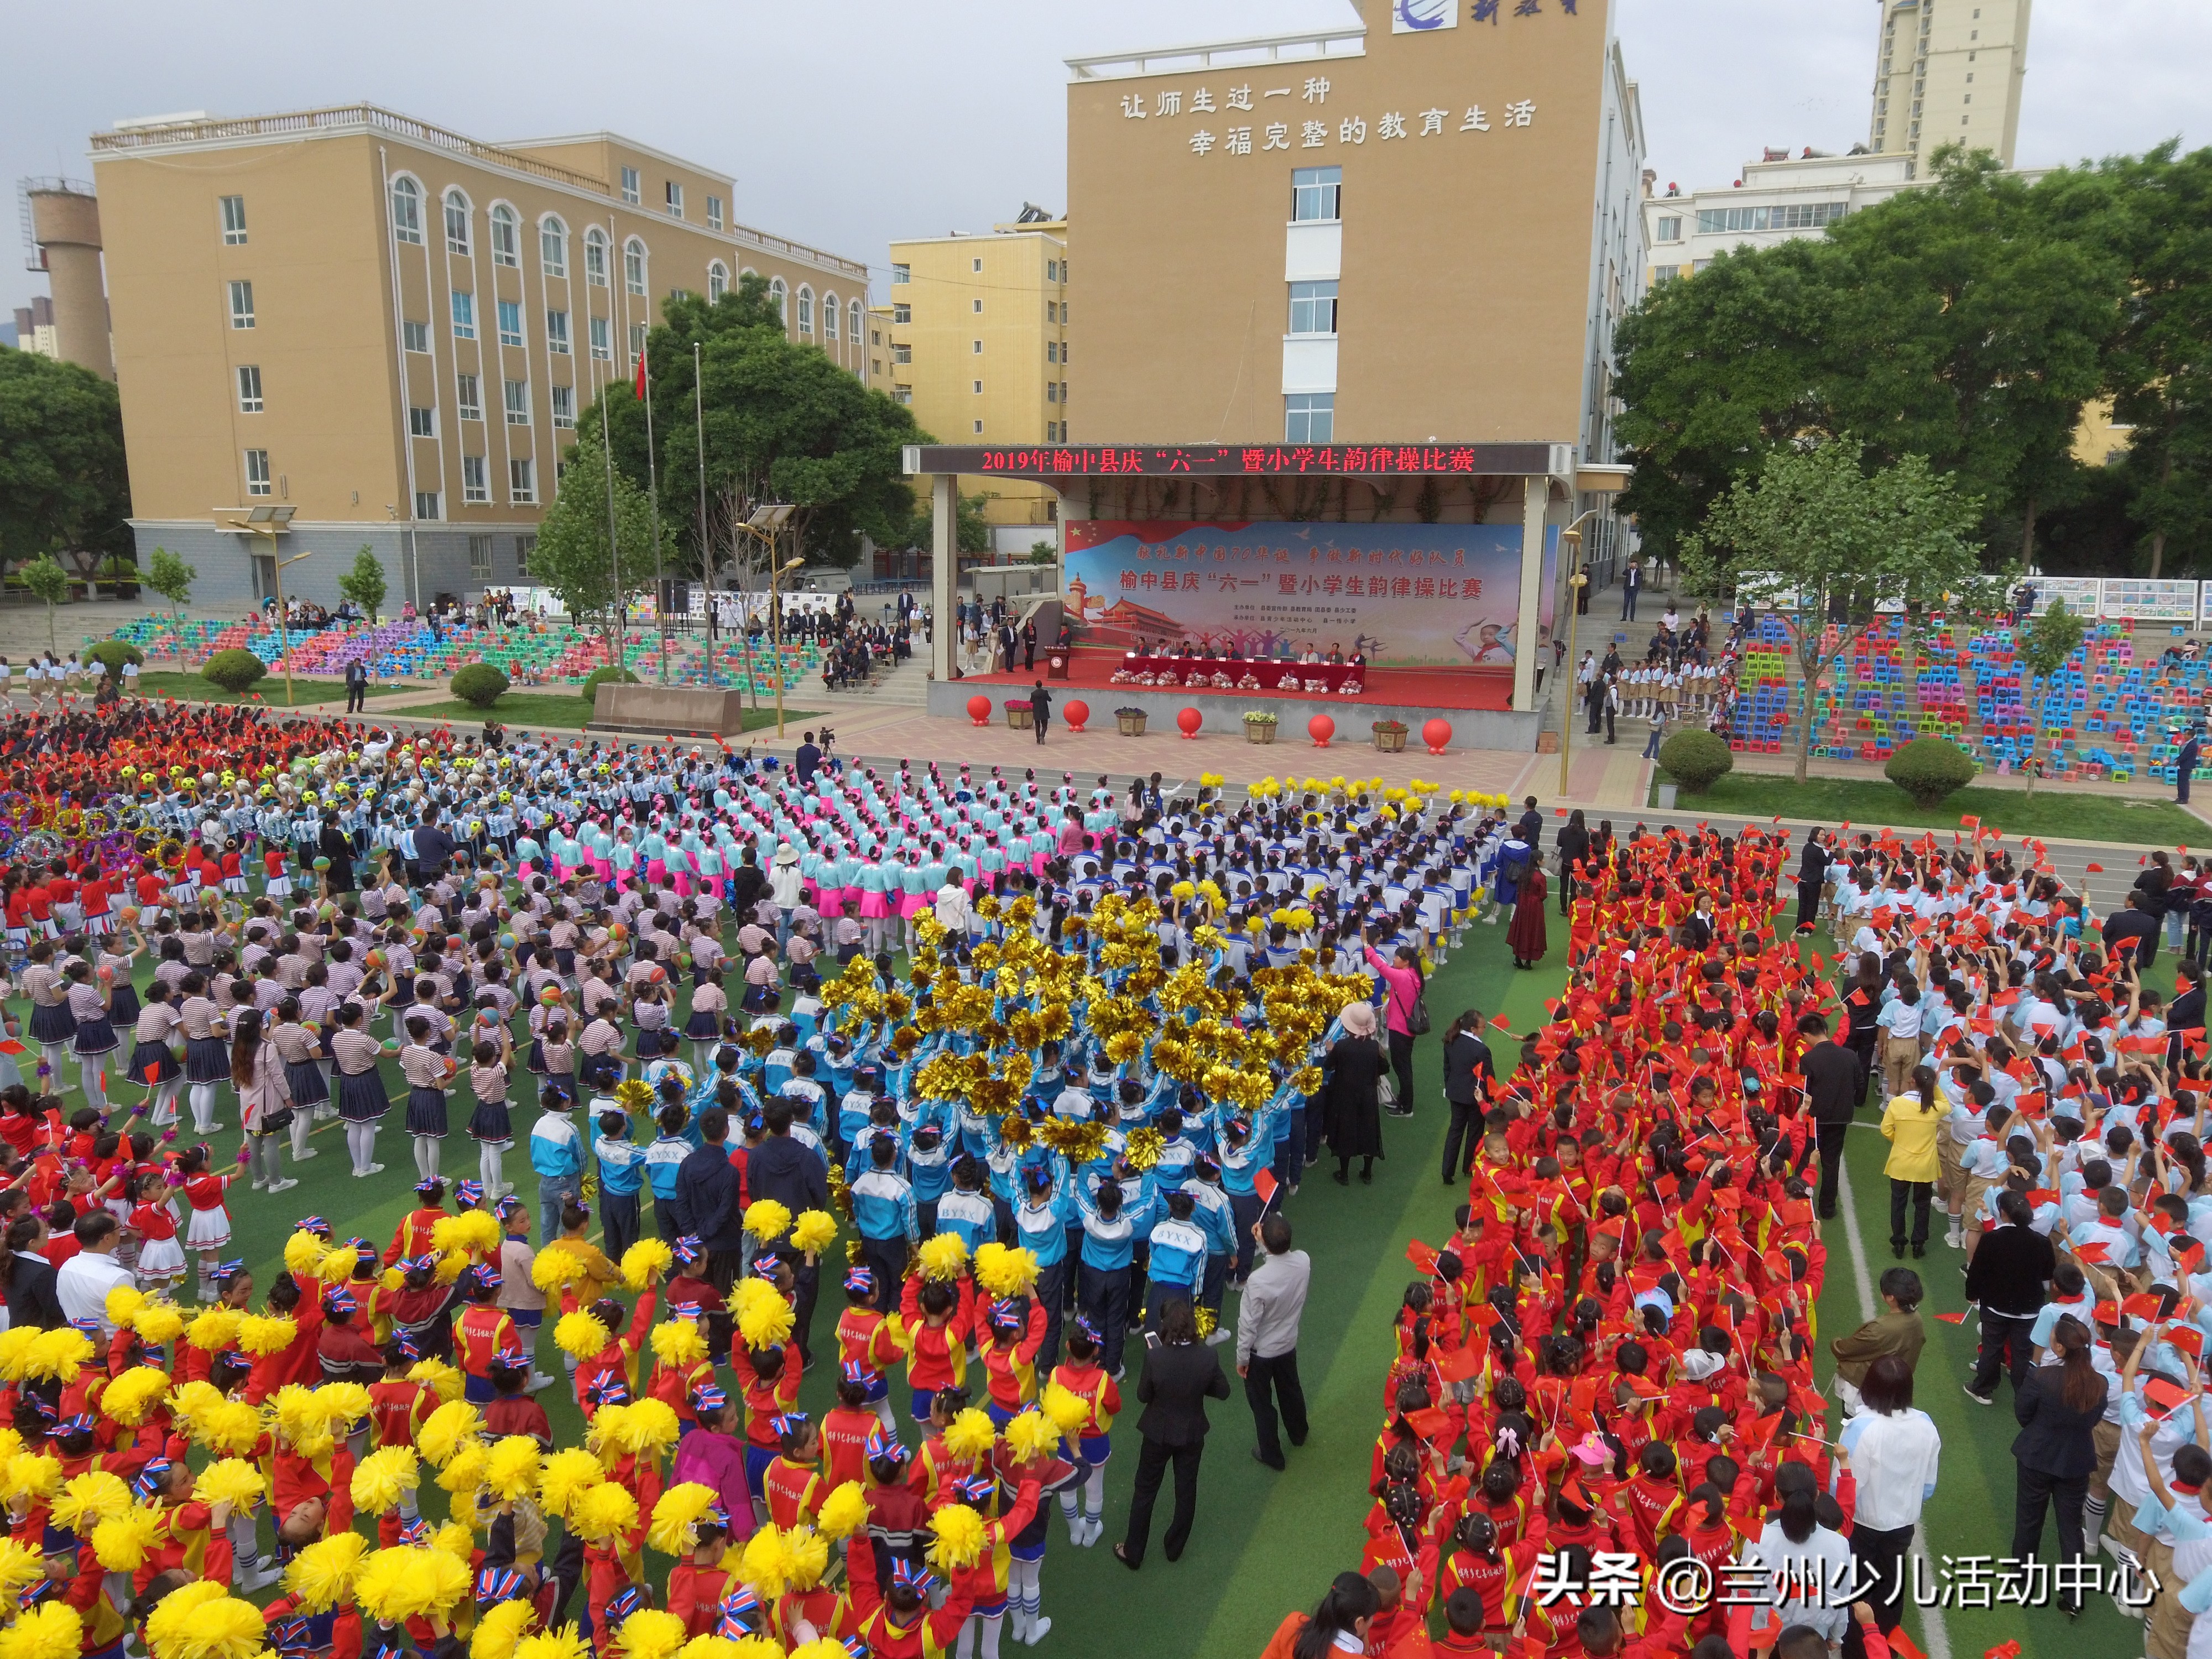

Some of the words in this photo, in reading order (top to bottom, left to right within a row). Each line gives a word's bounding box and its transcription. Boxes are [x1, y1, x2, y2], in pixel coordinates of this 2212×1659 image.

[1120, 76, 1331, 120] 让师生过一种
[1188, 99, 1537, 157] 幸福完整的教育生活
[942, 1208, 975, 1220] BYXX
[1157, 1230, 1191, 1245] BYXX
